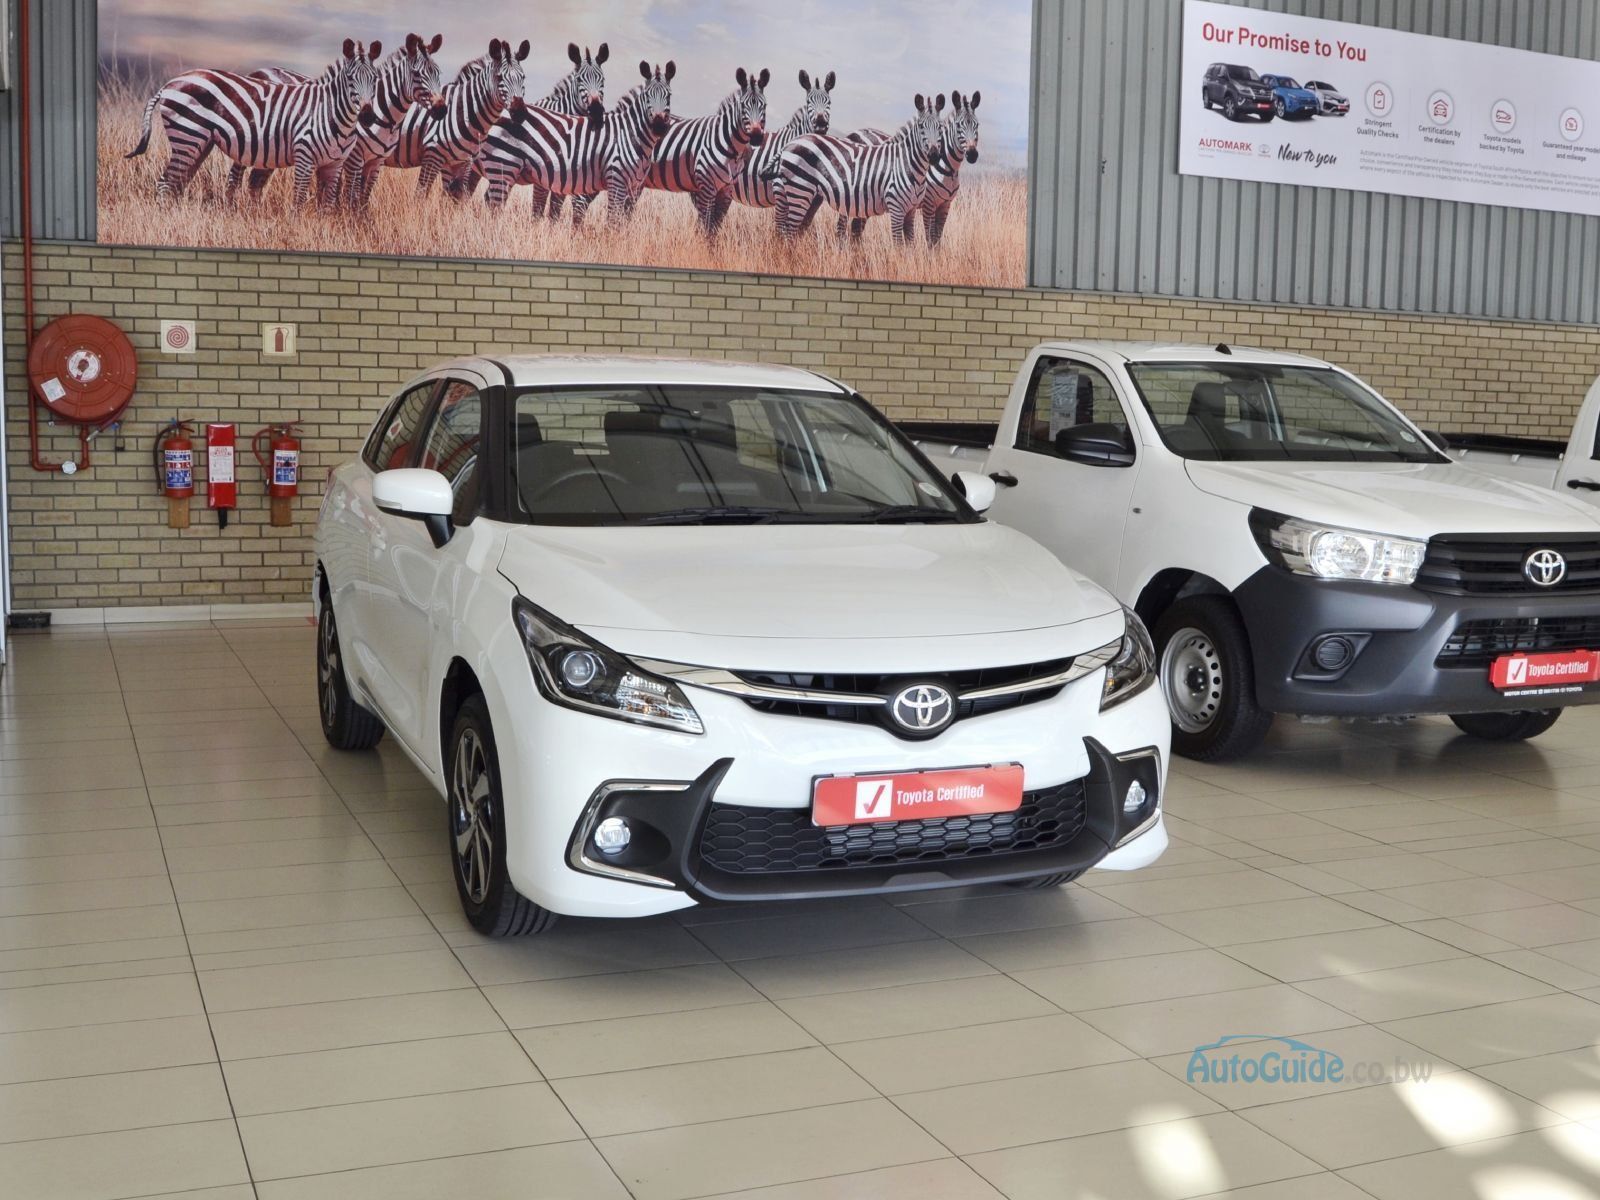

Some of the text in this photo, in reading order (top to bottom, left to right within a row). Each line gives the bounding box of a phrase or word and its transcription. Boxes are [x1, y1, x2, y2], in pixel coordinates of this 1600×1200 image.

[1202, 22, 1367, 62] Our Promise to You
[1364, 118, 1392, 128] Stringent
[1356, 127, 1399, 139] Quality Checks
[1418, 125, 1453, 136] Certification
[1434, 137, 1455, 145] dealers
[1484, 134, 1501, 142] Toyota
[1198, 138, 1252, 151] AUTOMARK
[1480, 143, 1499, 151] backed
[1507, 146, 1524, 155] Toyota
[1542, 141, 1572, 150] Guaranteed
[1278, 143, 1337, 168] New to you
[1528, 661, 1589, 677] Toyota Certified
[897, 784, 984, 805] Toyota Certified
